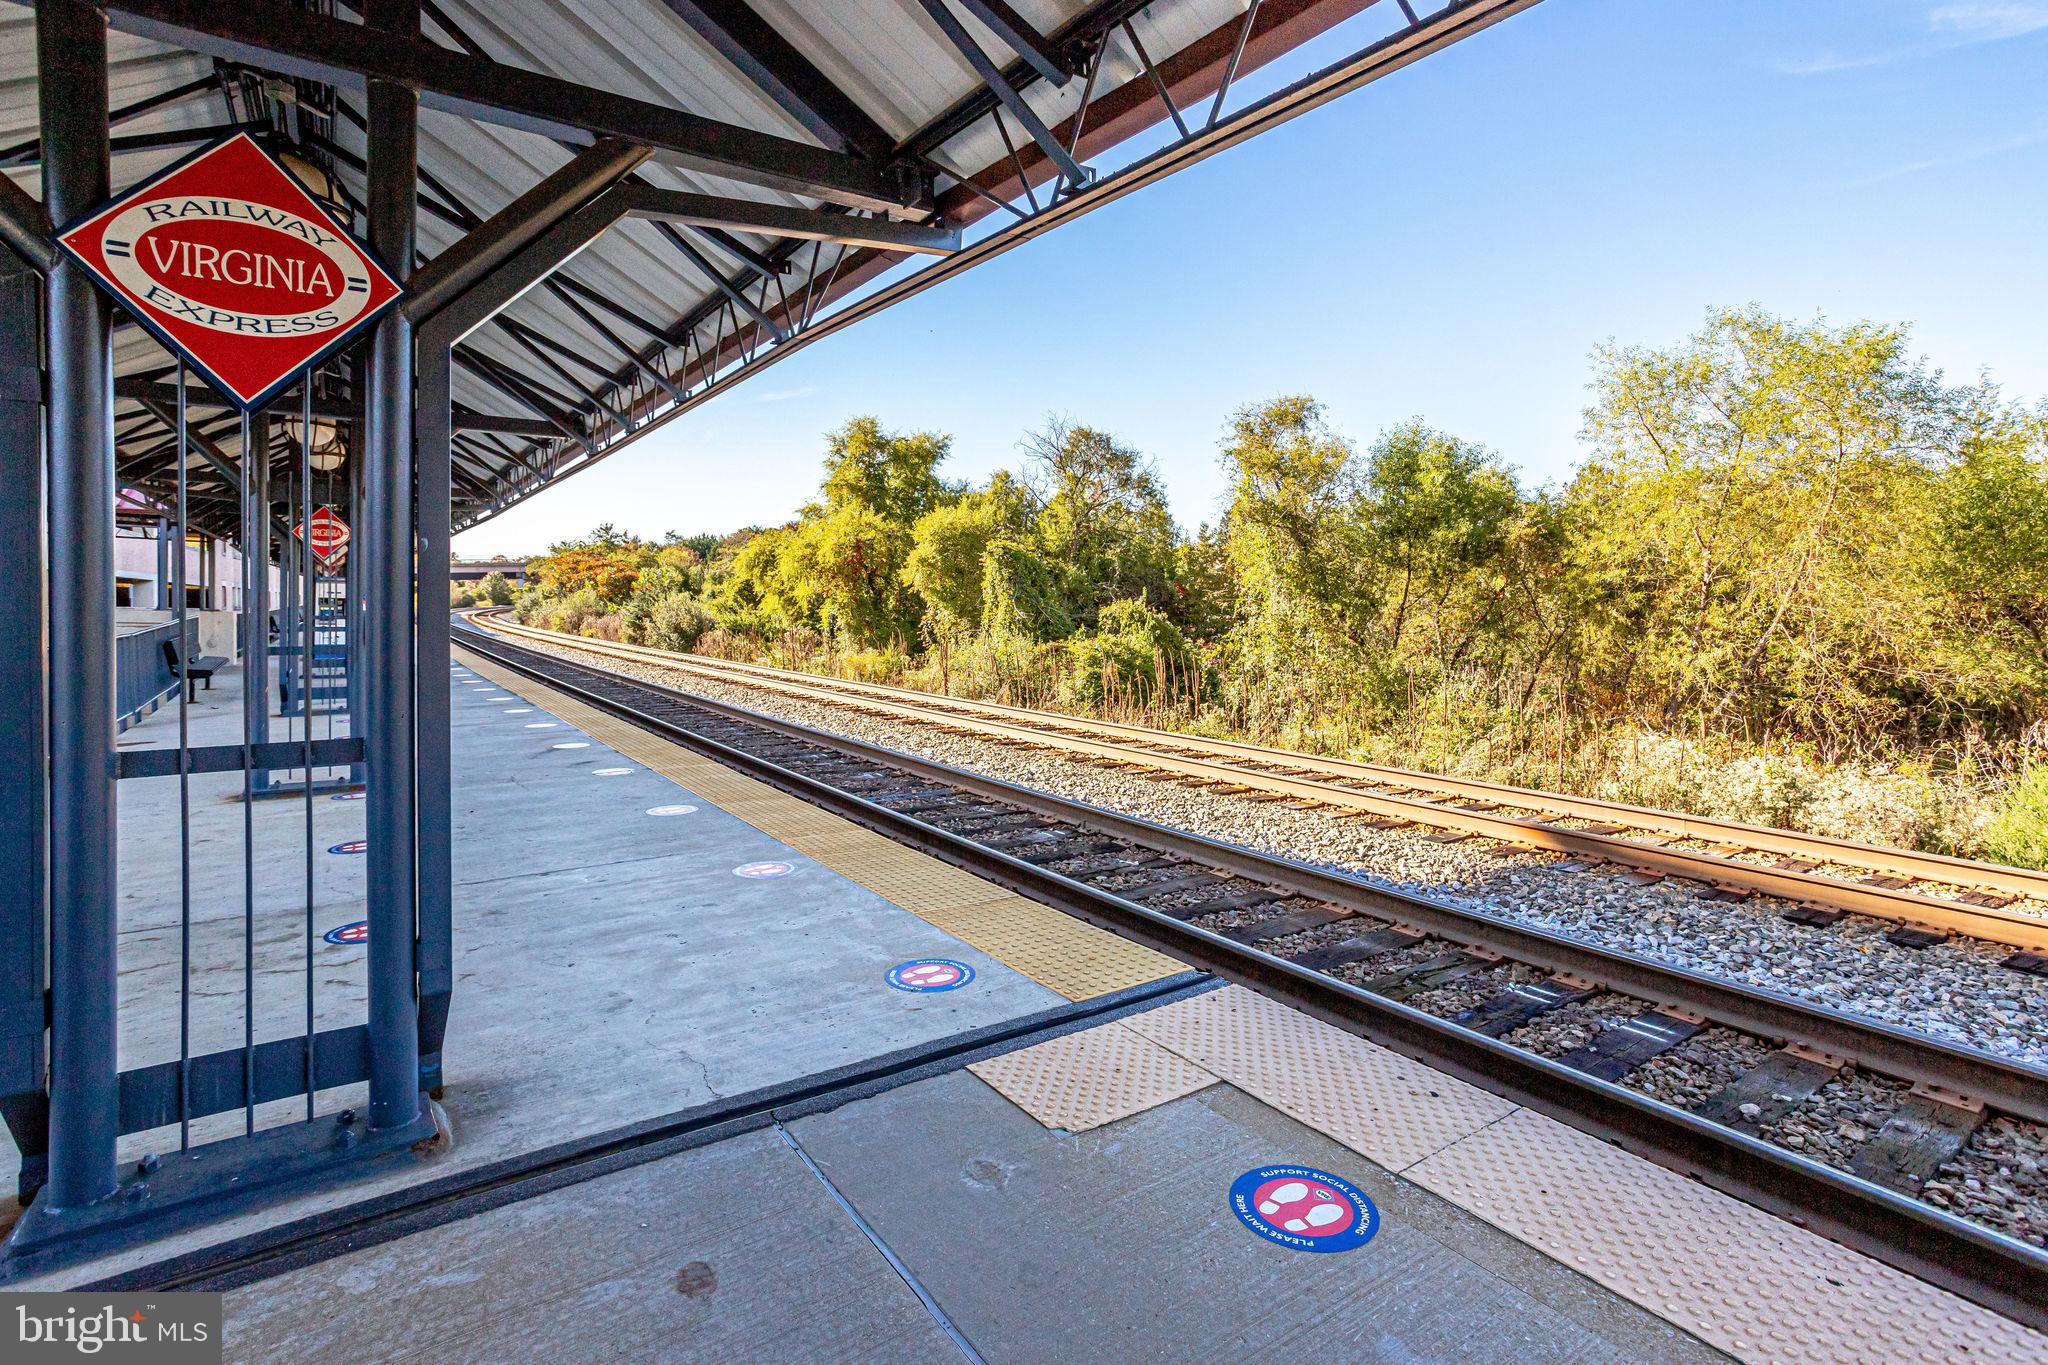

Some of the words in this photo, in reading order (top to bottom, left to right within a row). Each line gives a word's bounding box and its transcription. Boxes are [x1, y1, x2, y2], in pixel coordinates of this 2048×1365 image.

[143, 200, 337, 247] RAILWAY
[147, 236, 335, 298] VIRGINIA
[144, 285, 339, 334] EXPRESS
[1235, 1193, 1249, 1213] HERE
[1244, 1213, 1268, 1233] WAIT
[1260, 1168, 1310, 1178] SUPPORT
[1312, 1173, 1350, 1192] SOCIAL
[1348, 1192, 1371, 1236] DISTANCING
[1268, 1230, 1315, 1247] PLEASE
